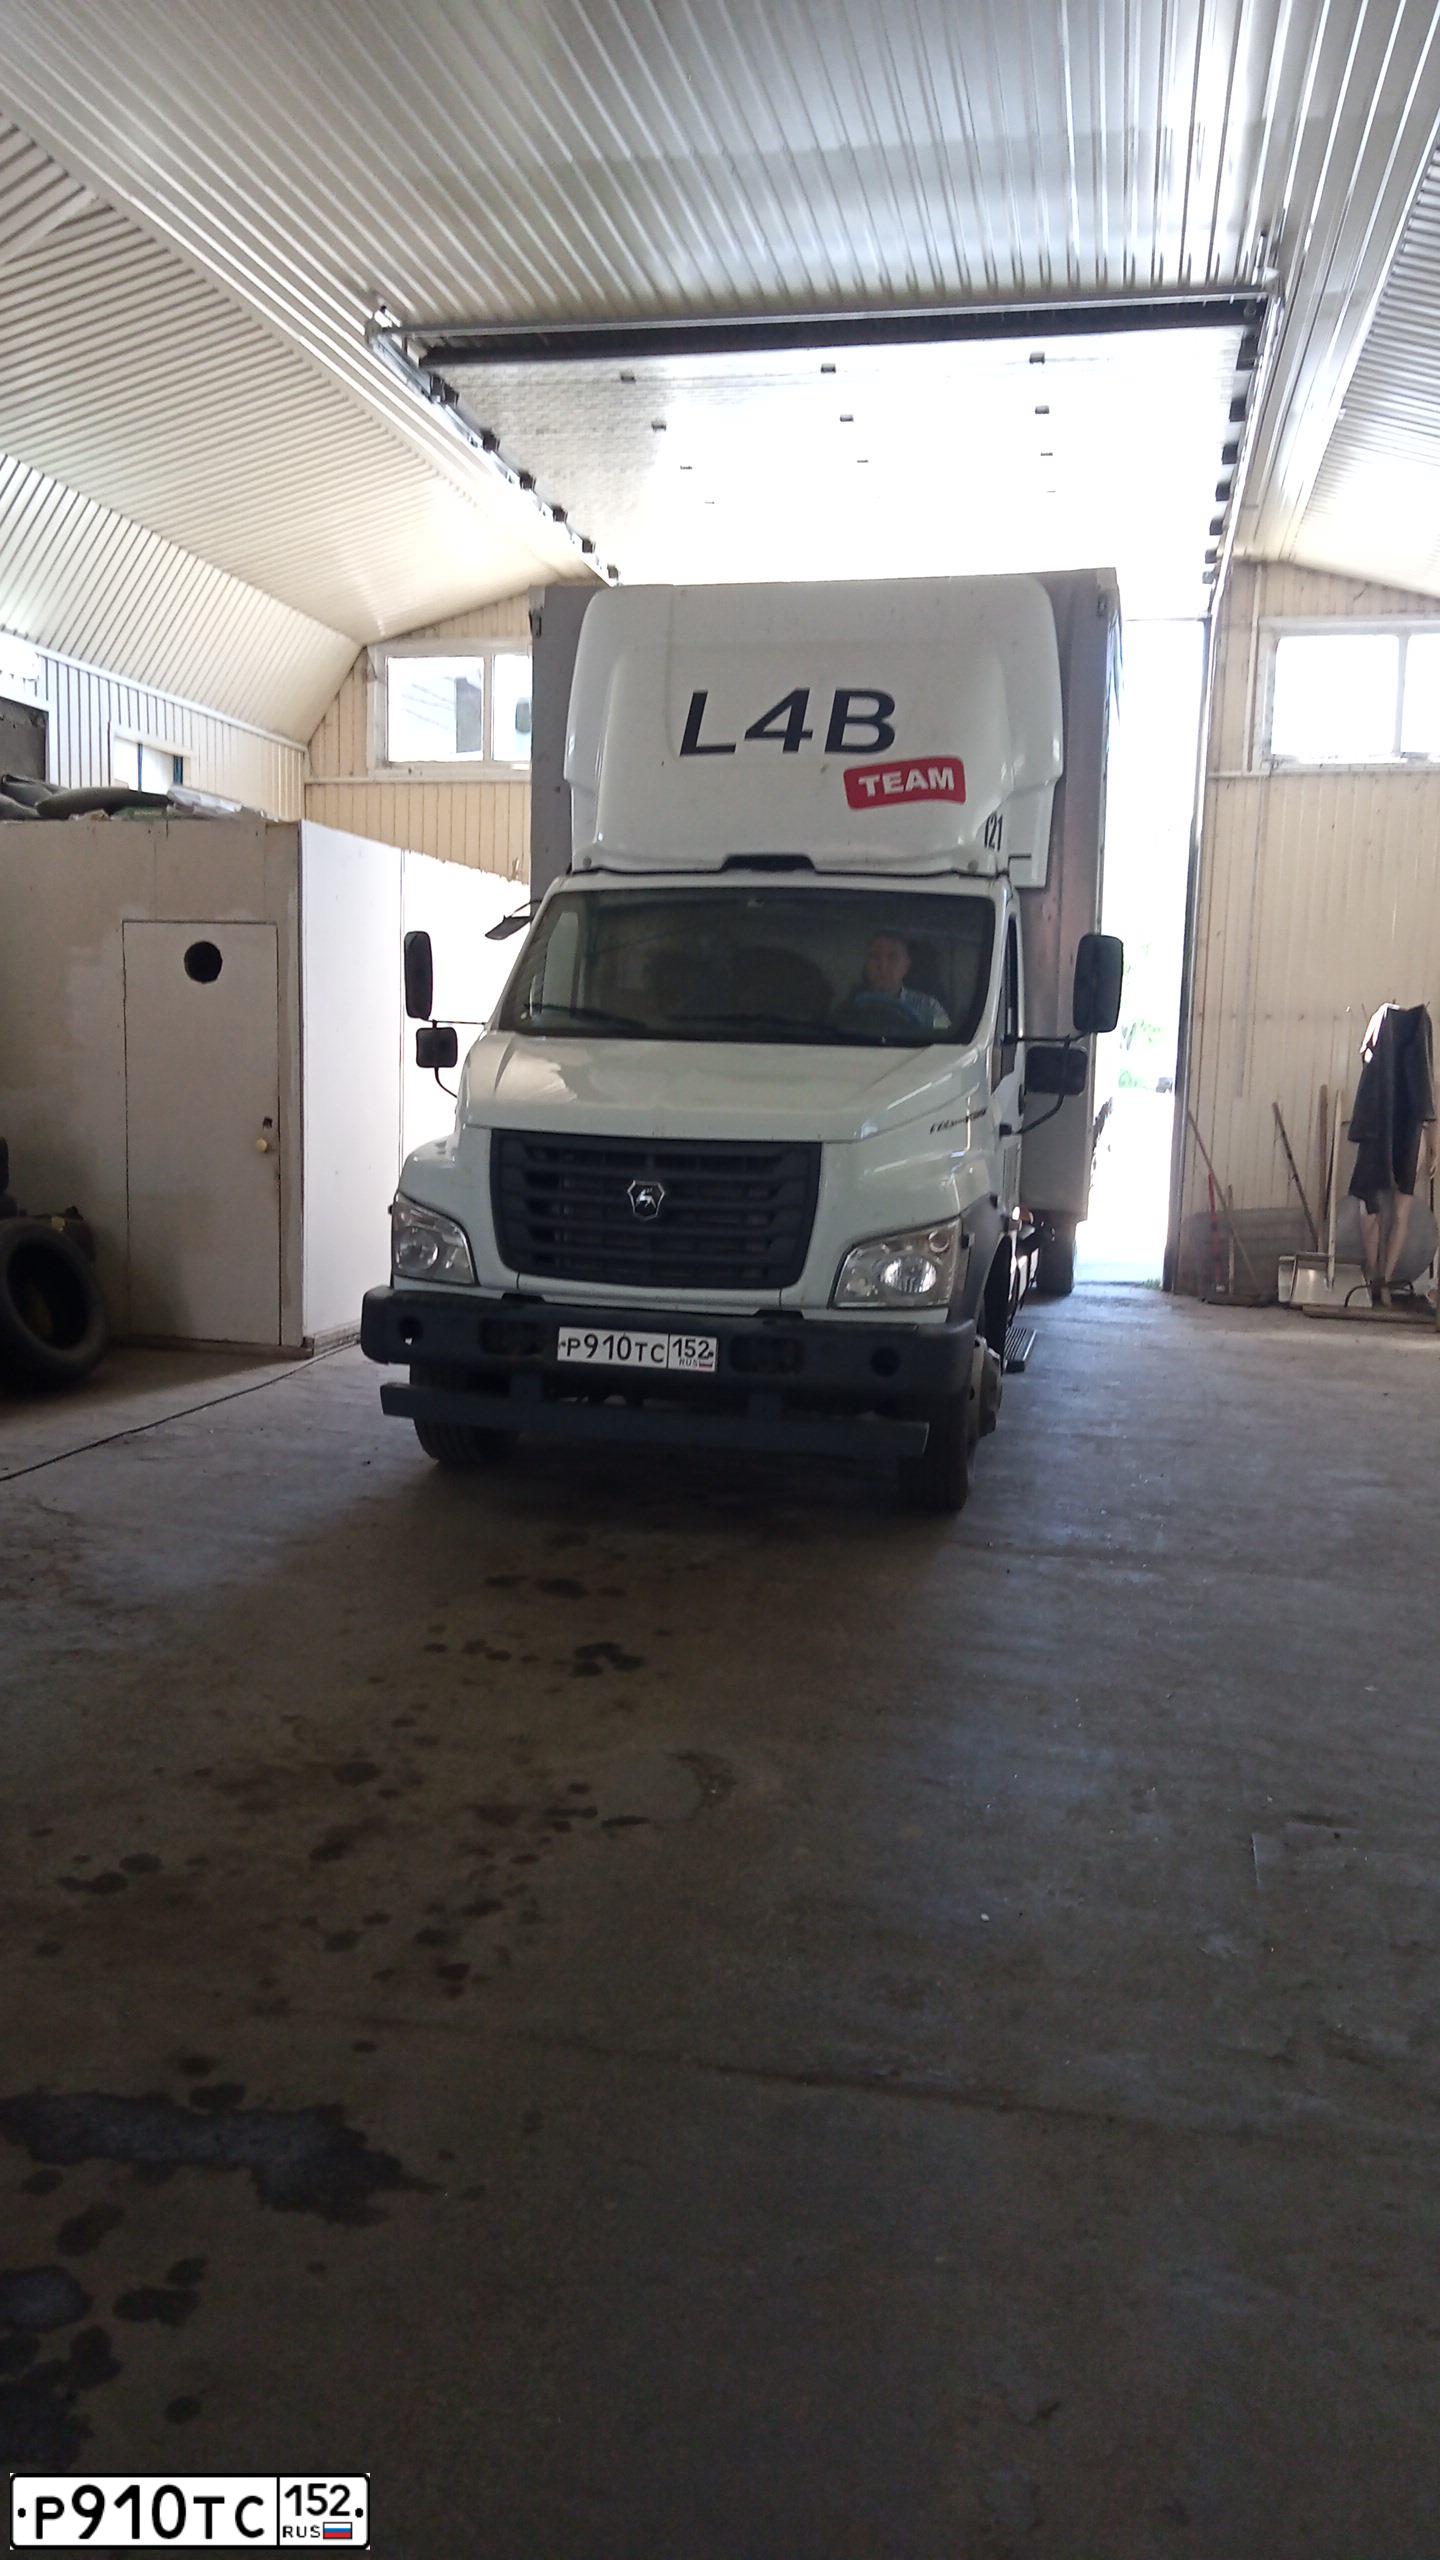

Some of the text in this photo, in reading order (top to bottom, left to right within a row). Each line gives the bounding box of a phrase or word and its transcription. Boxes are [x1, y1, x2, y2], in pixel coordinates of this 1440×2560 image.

[680, 687, 896, 756] L4B
[858, 767, 955, 797] TEAM
[672, 1338, 710, 1359] 152
[679, 1358, 698, 1367] RUS
